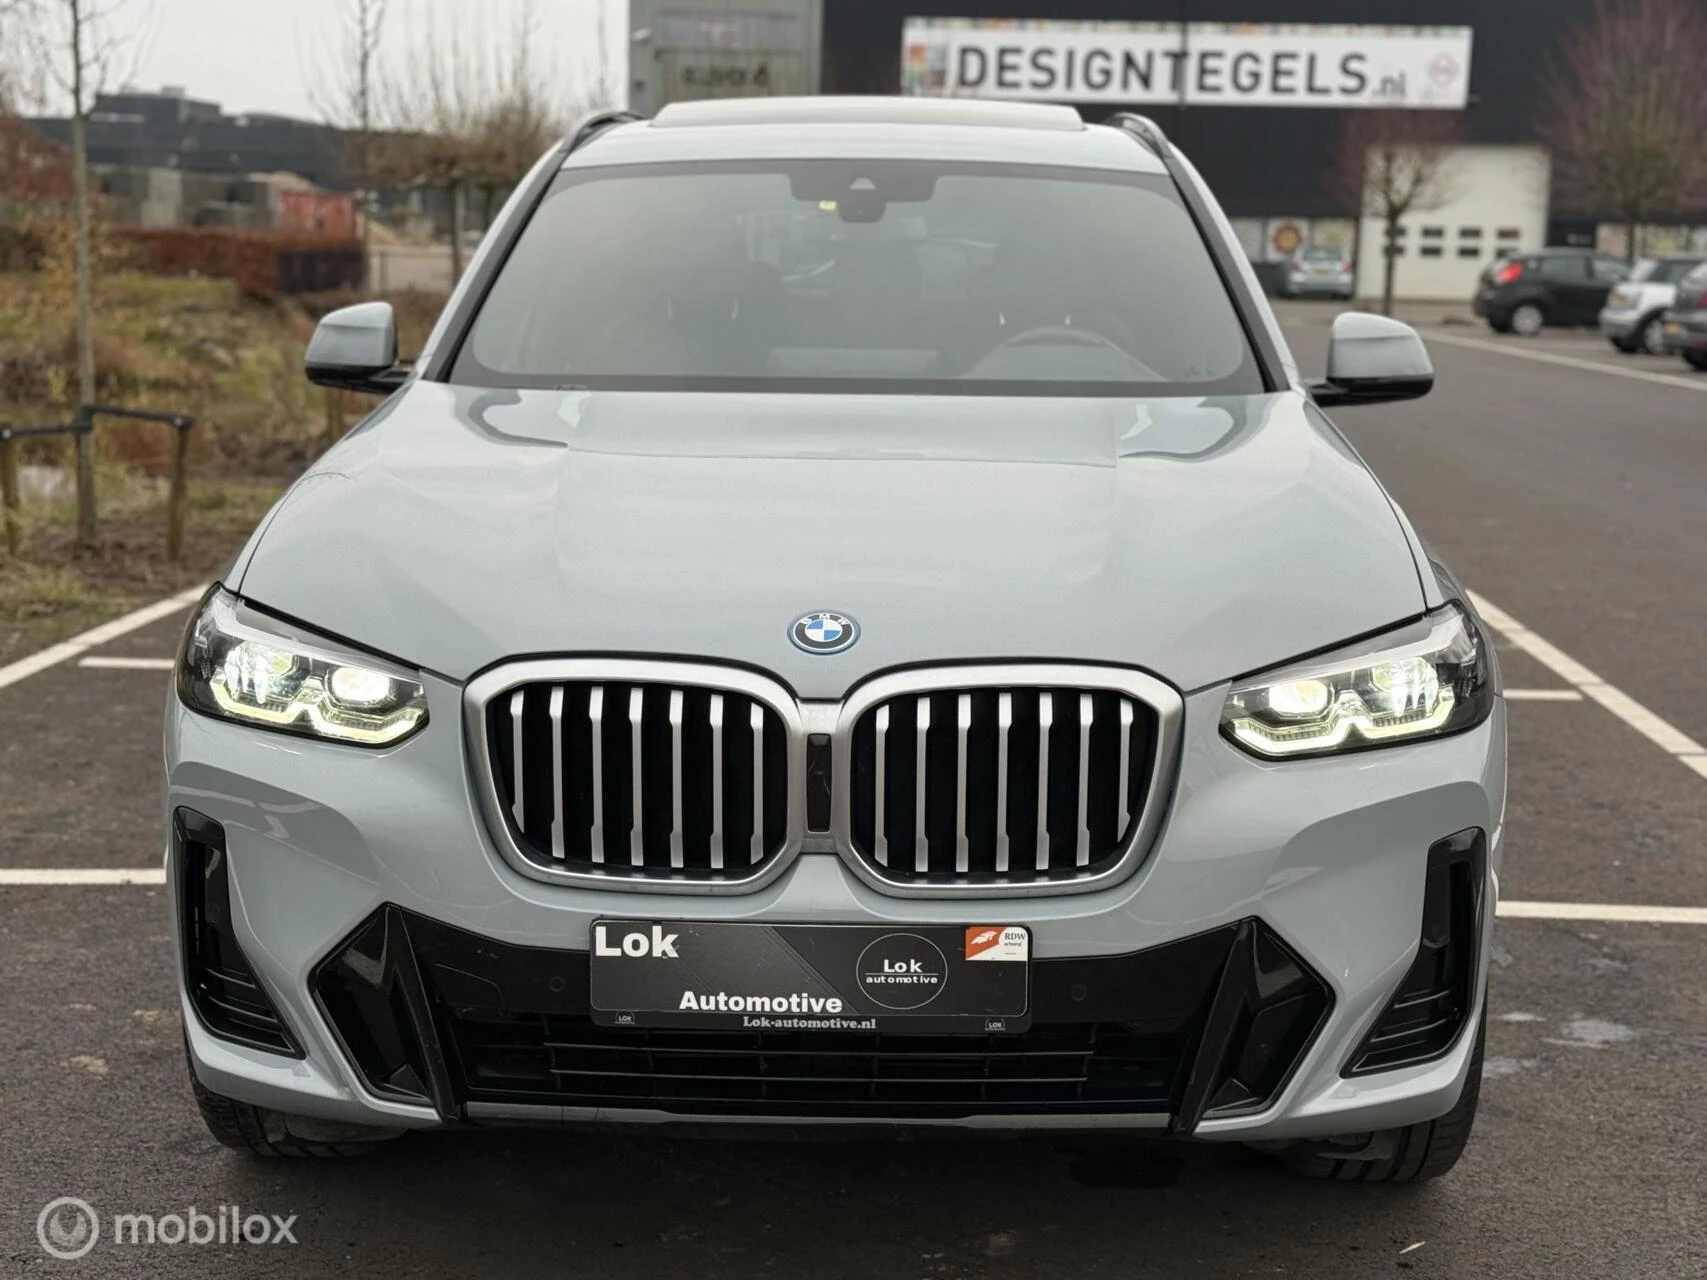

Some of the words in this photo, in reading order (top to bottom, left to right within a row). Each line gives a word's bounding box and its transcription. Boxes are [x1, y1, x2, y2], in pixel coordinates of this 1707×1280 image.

[957, 46, 1406, 97] DESIGNTEGELS.nl
[595, 925, 679, 958] Lok
[1004, 932, 1026, 941] RDW
[883, 959, 923, 973] Lok
[866, 975, 938, 984] automotive
[679, 991, 842, 1013] Automotive
[743, 1016, 877, 1029] Lok-automotive.nl
